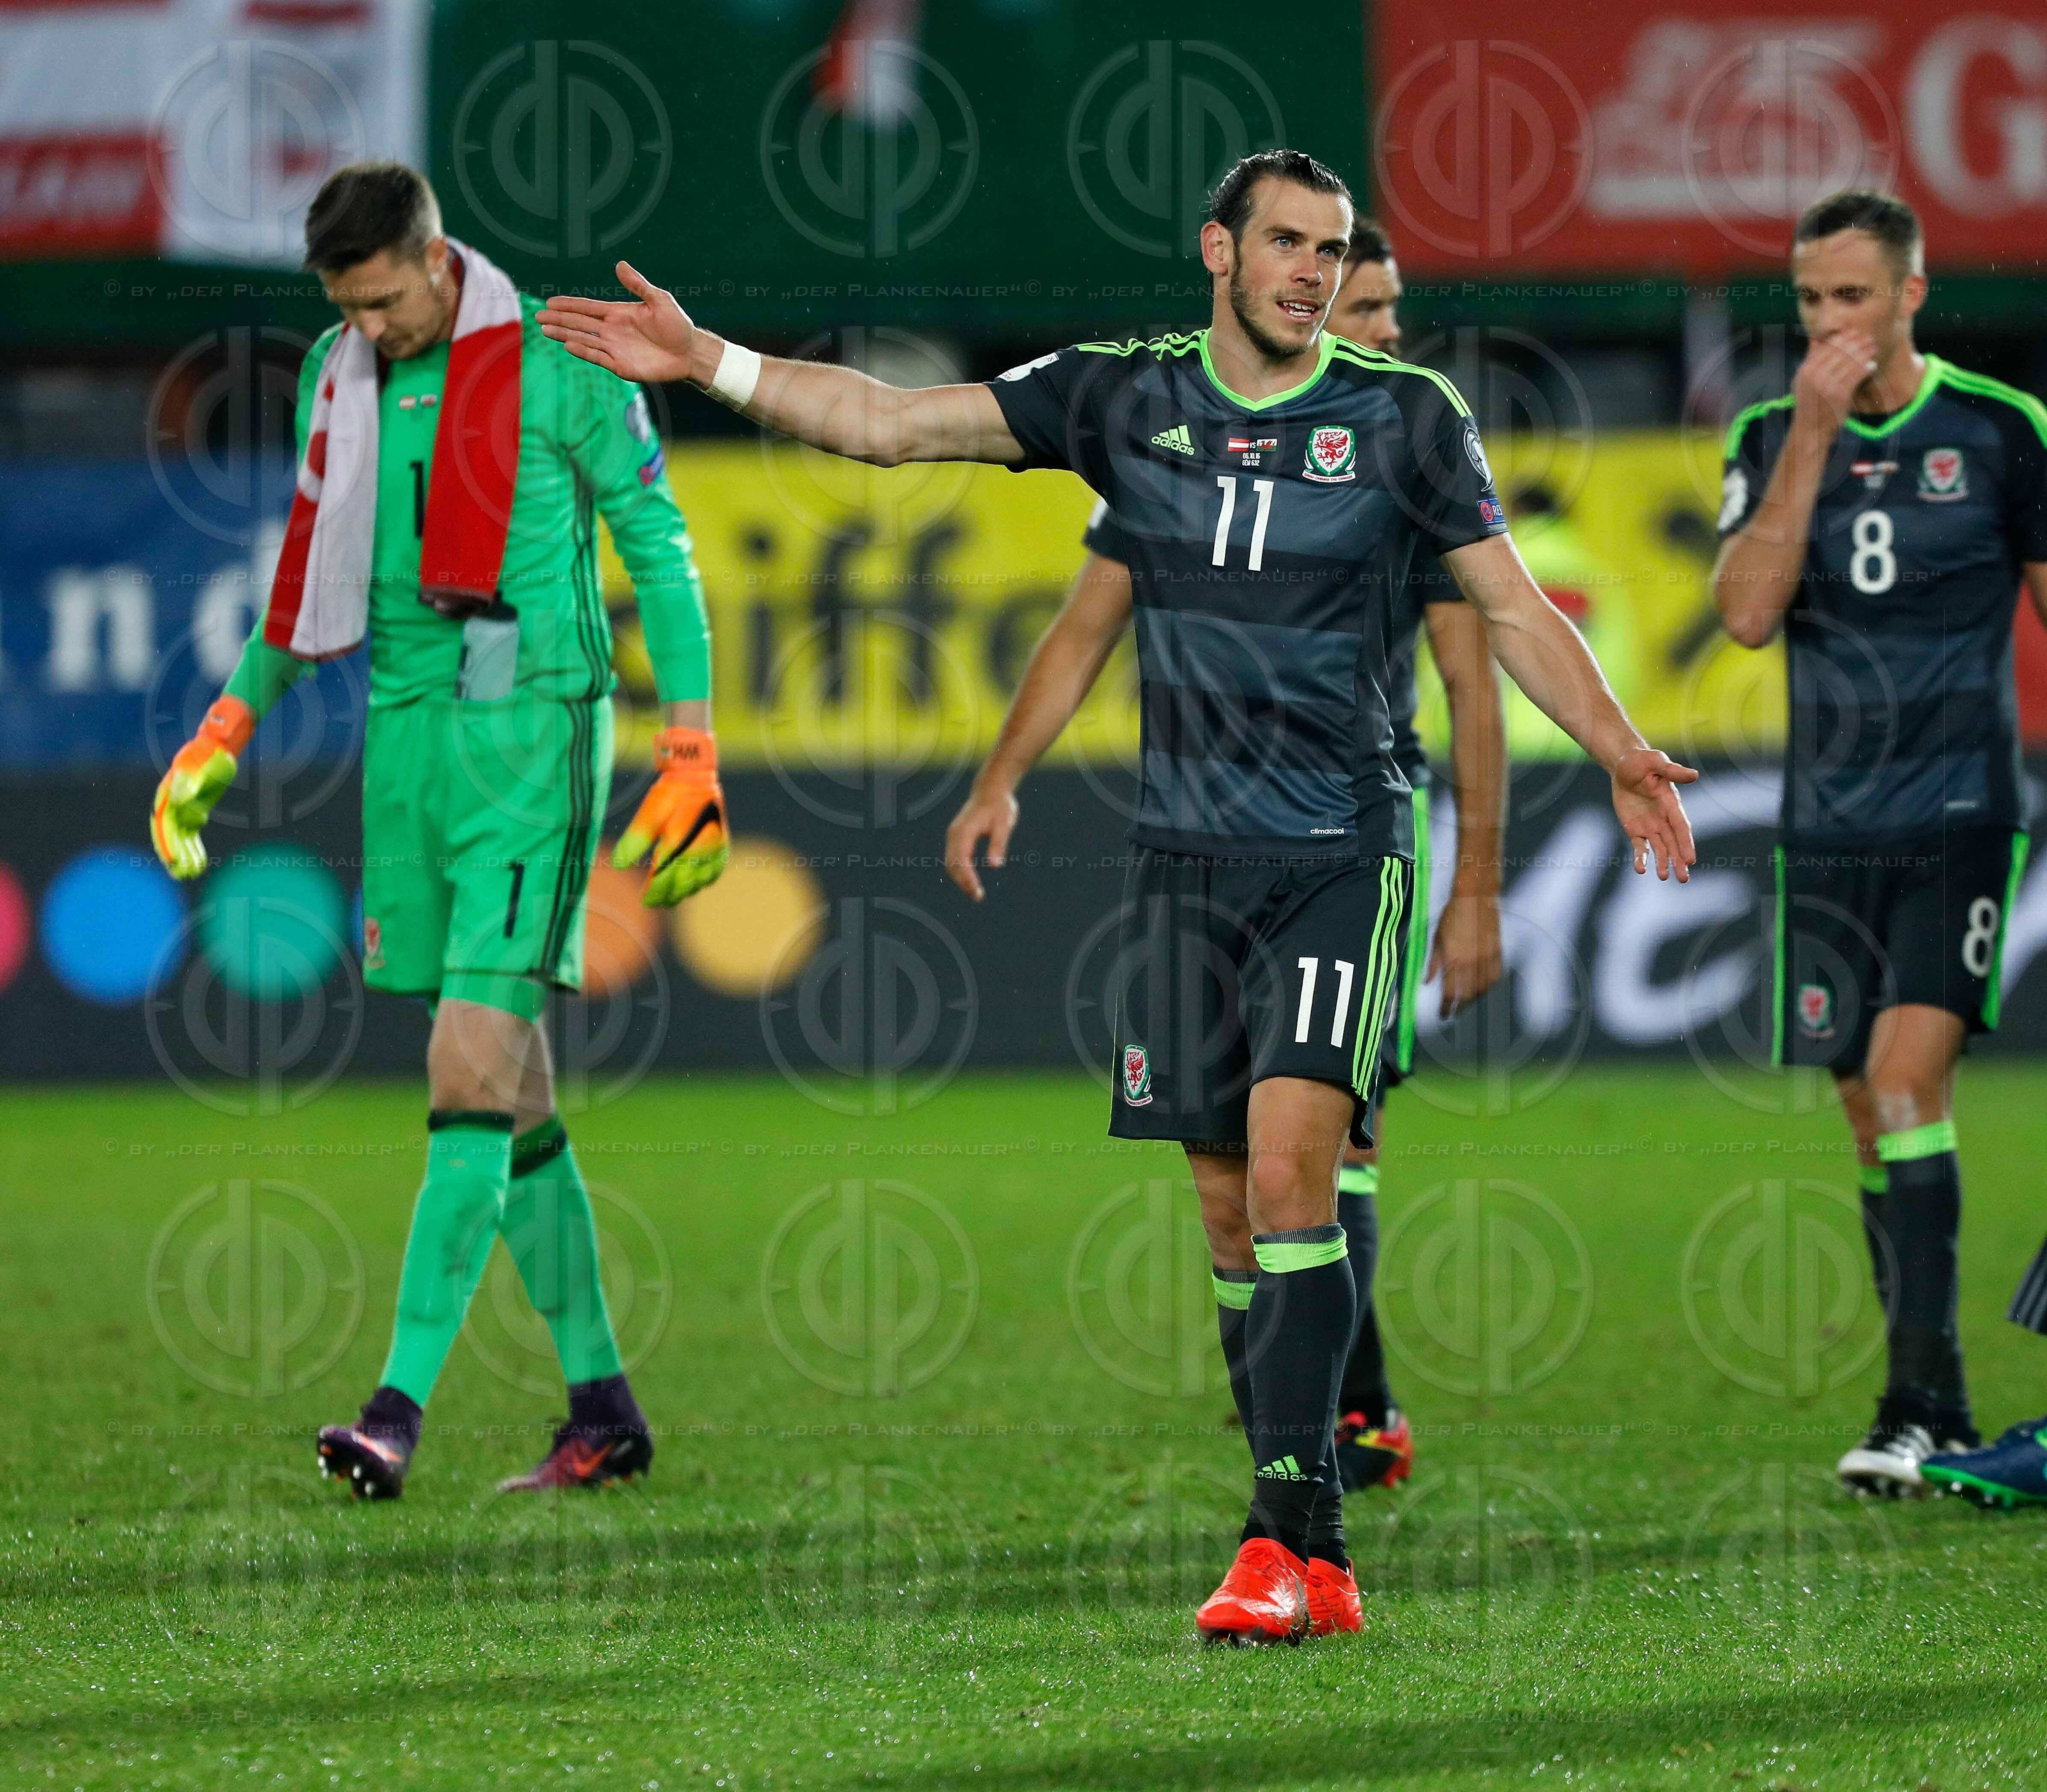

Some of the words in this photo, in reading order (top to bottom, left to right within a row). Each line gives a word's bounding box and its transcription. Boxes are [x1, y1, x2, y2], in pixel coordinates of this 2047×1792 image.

[1151, 435, 1195, 455] adidas
[1212, 476, 1274, 572] 11
[1850, 511, 1897, 595] 8
[503, 861, 525, 938] 1
[1962, 896, 2000, 978] 8
[1294, 957, 1355, 1048] 11
[1257, 1470, 1308, 1481] adidas
